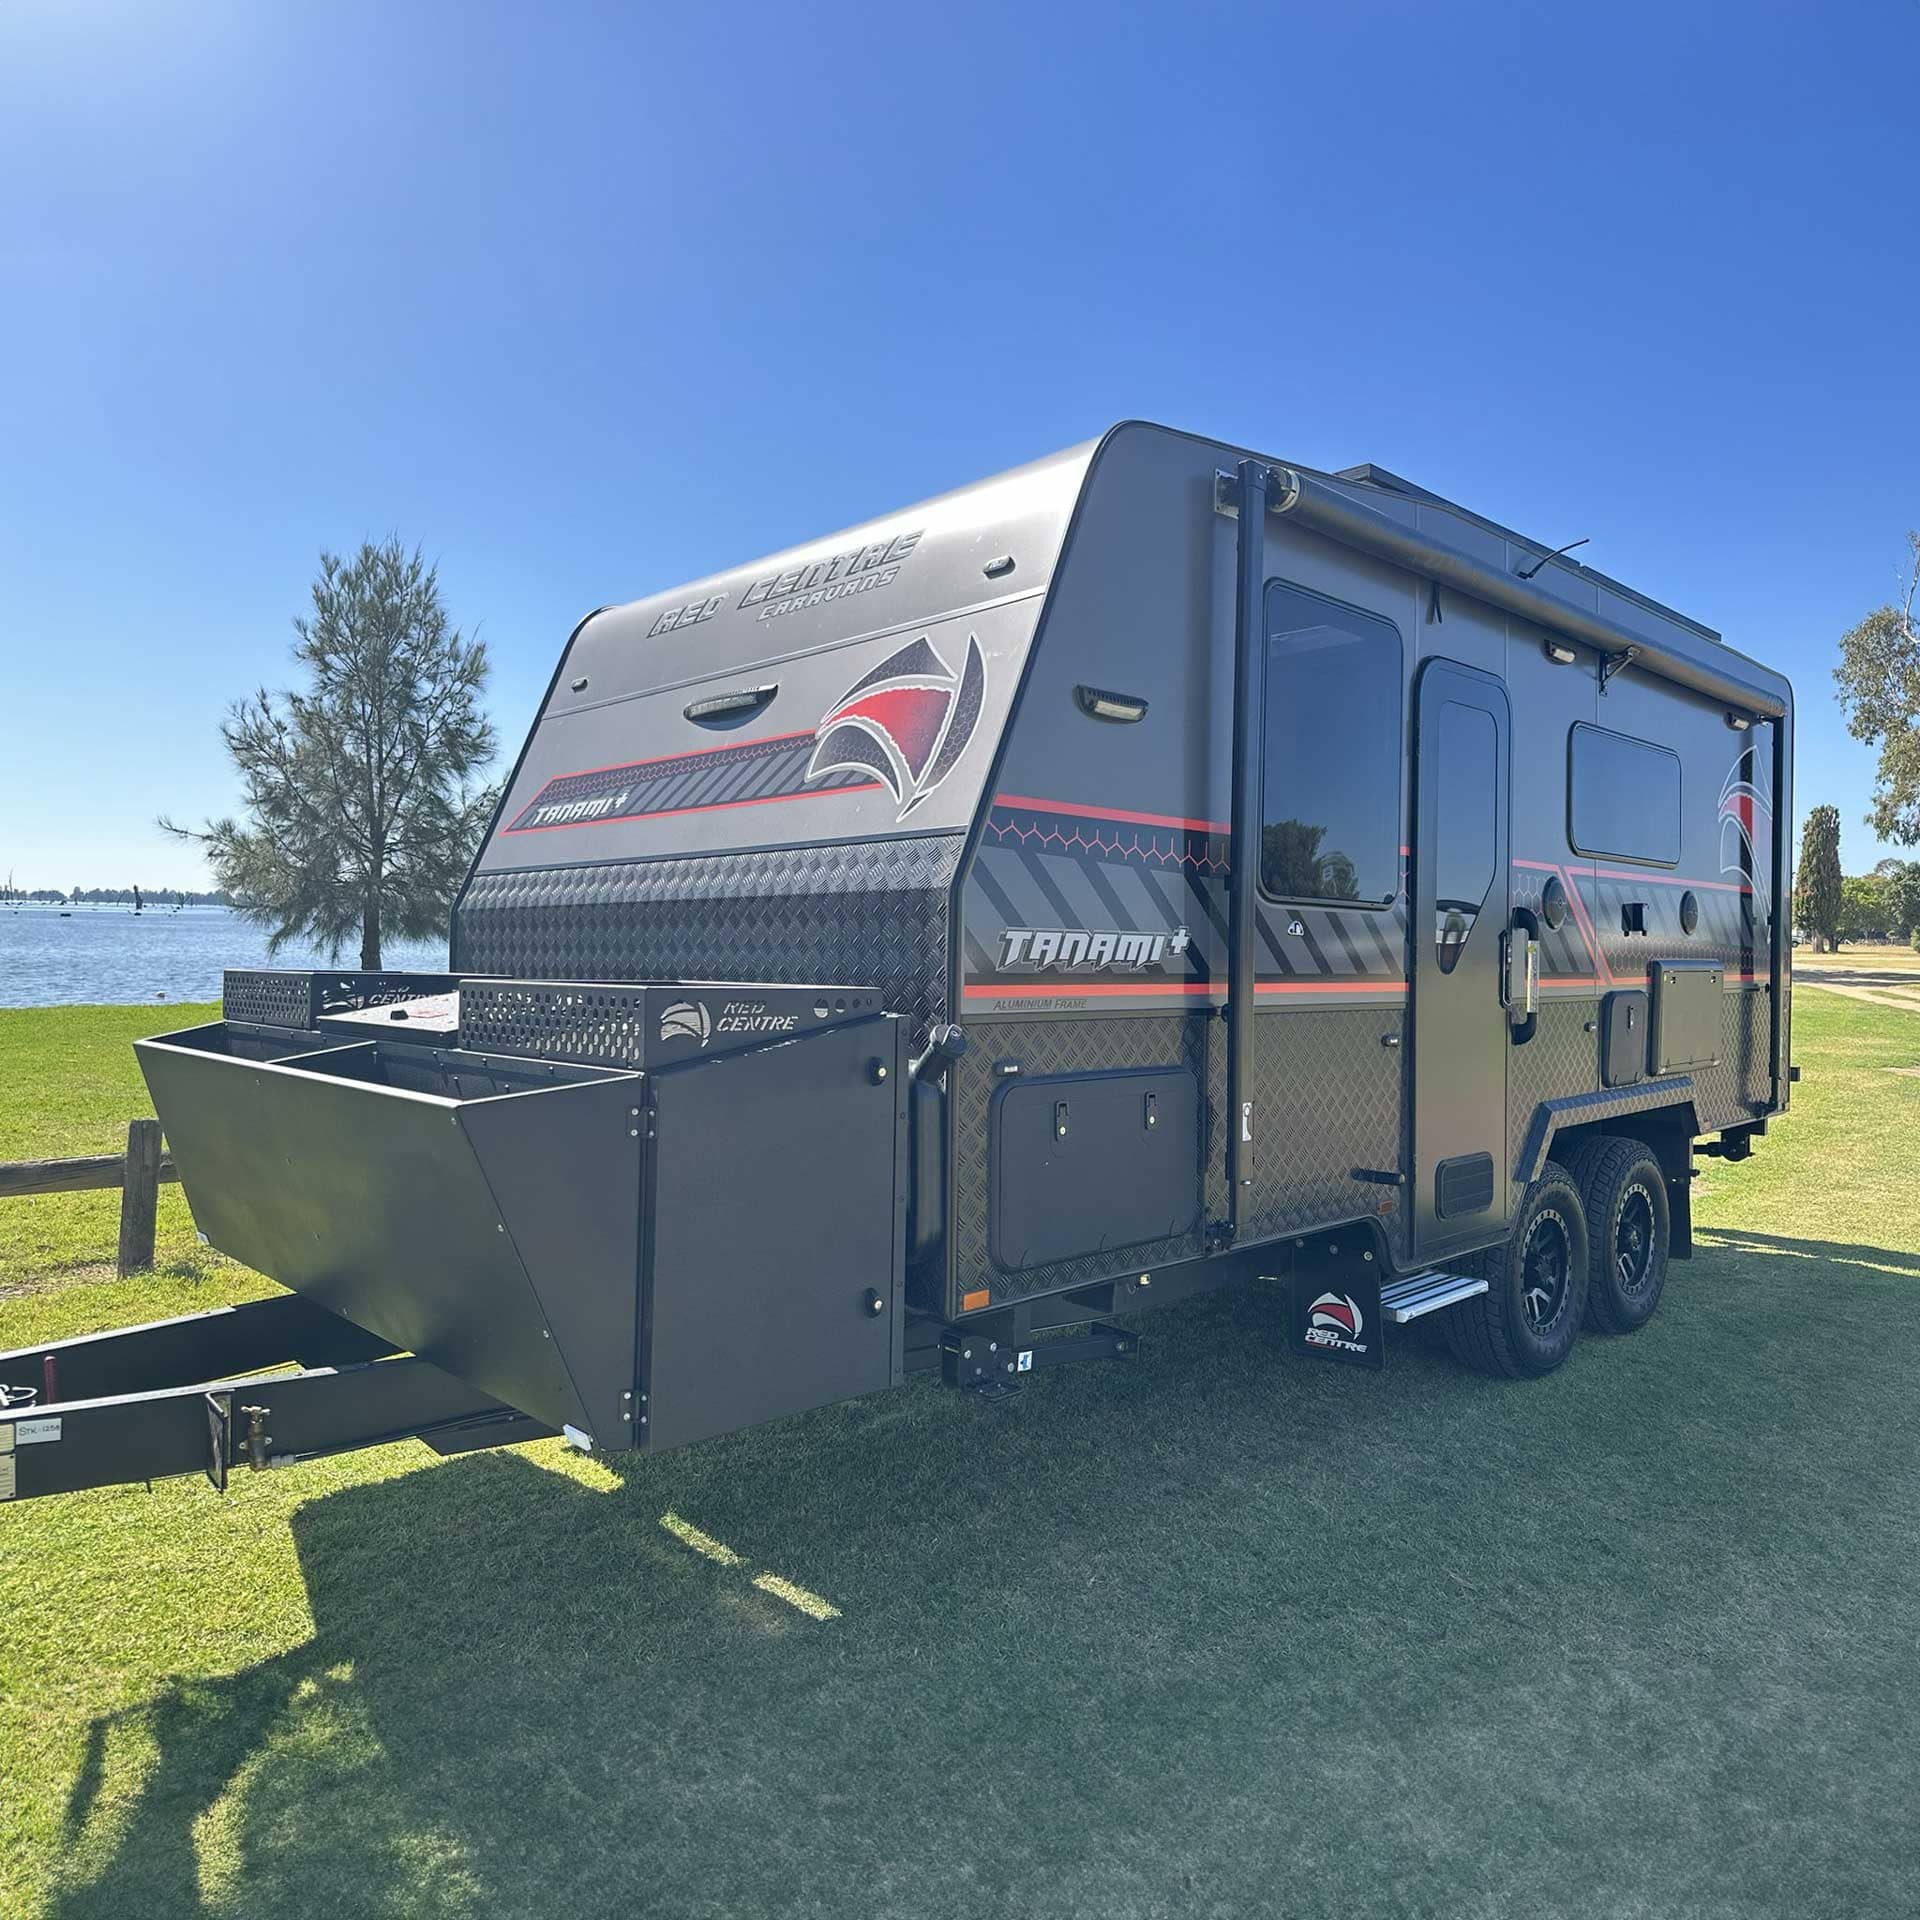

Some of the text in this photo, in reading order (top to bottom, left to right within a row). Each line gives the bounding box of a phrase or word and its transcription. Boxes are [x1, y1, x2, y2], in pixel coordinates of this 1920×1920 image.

[647, 529, 925, 638] RED CENTRE
[757, 566, 901, 622] CARAVANS
[724, 1001, 765, 1014] RED
[993, 999, 1088, 1010] ALUMINIUM FRAME
[716, 1016, 798, 1031] CENTRE
[1306, 1327, 1339, 1339] RED
[1304, 1334, 1368, 1352] CENTRE
